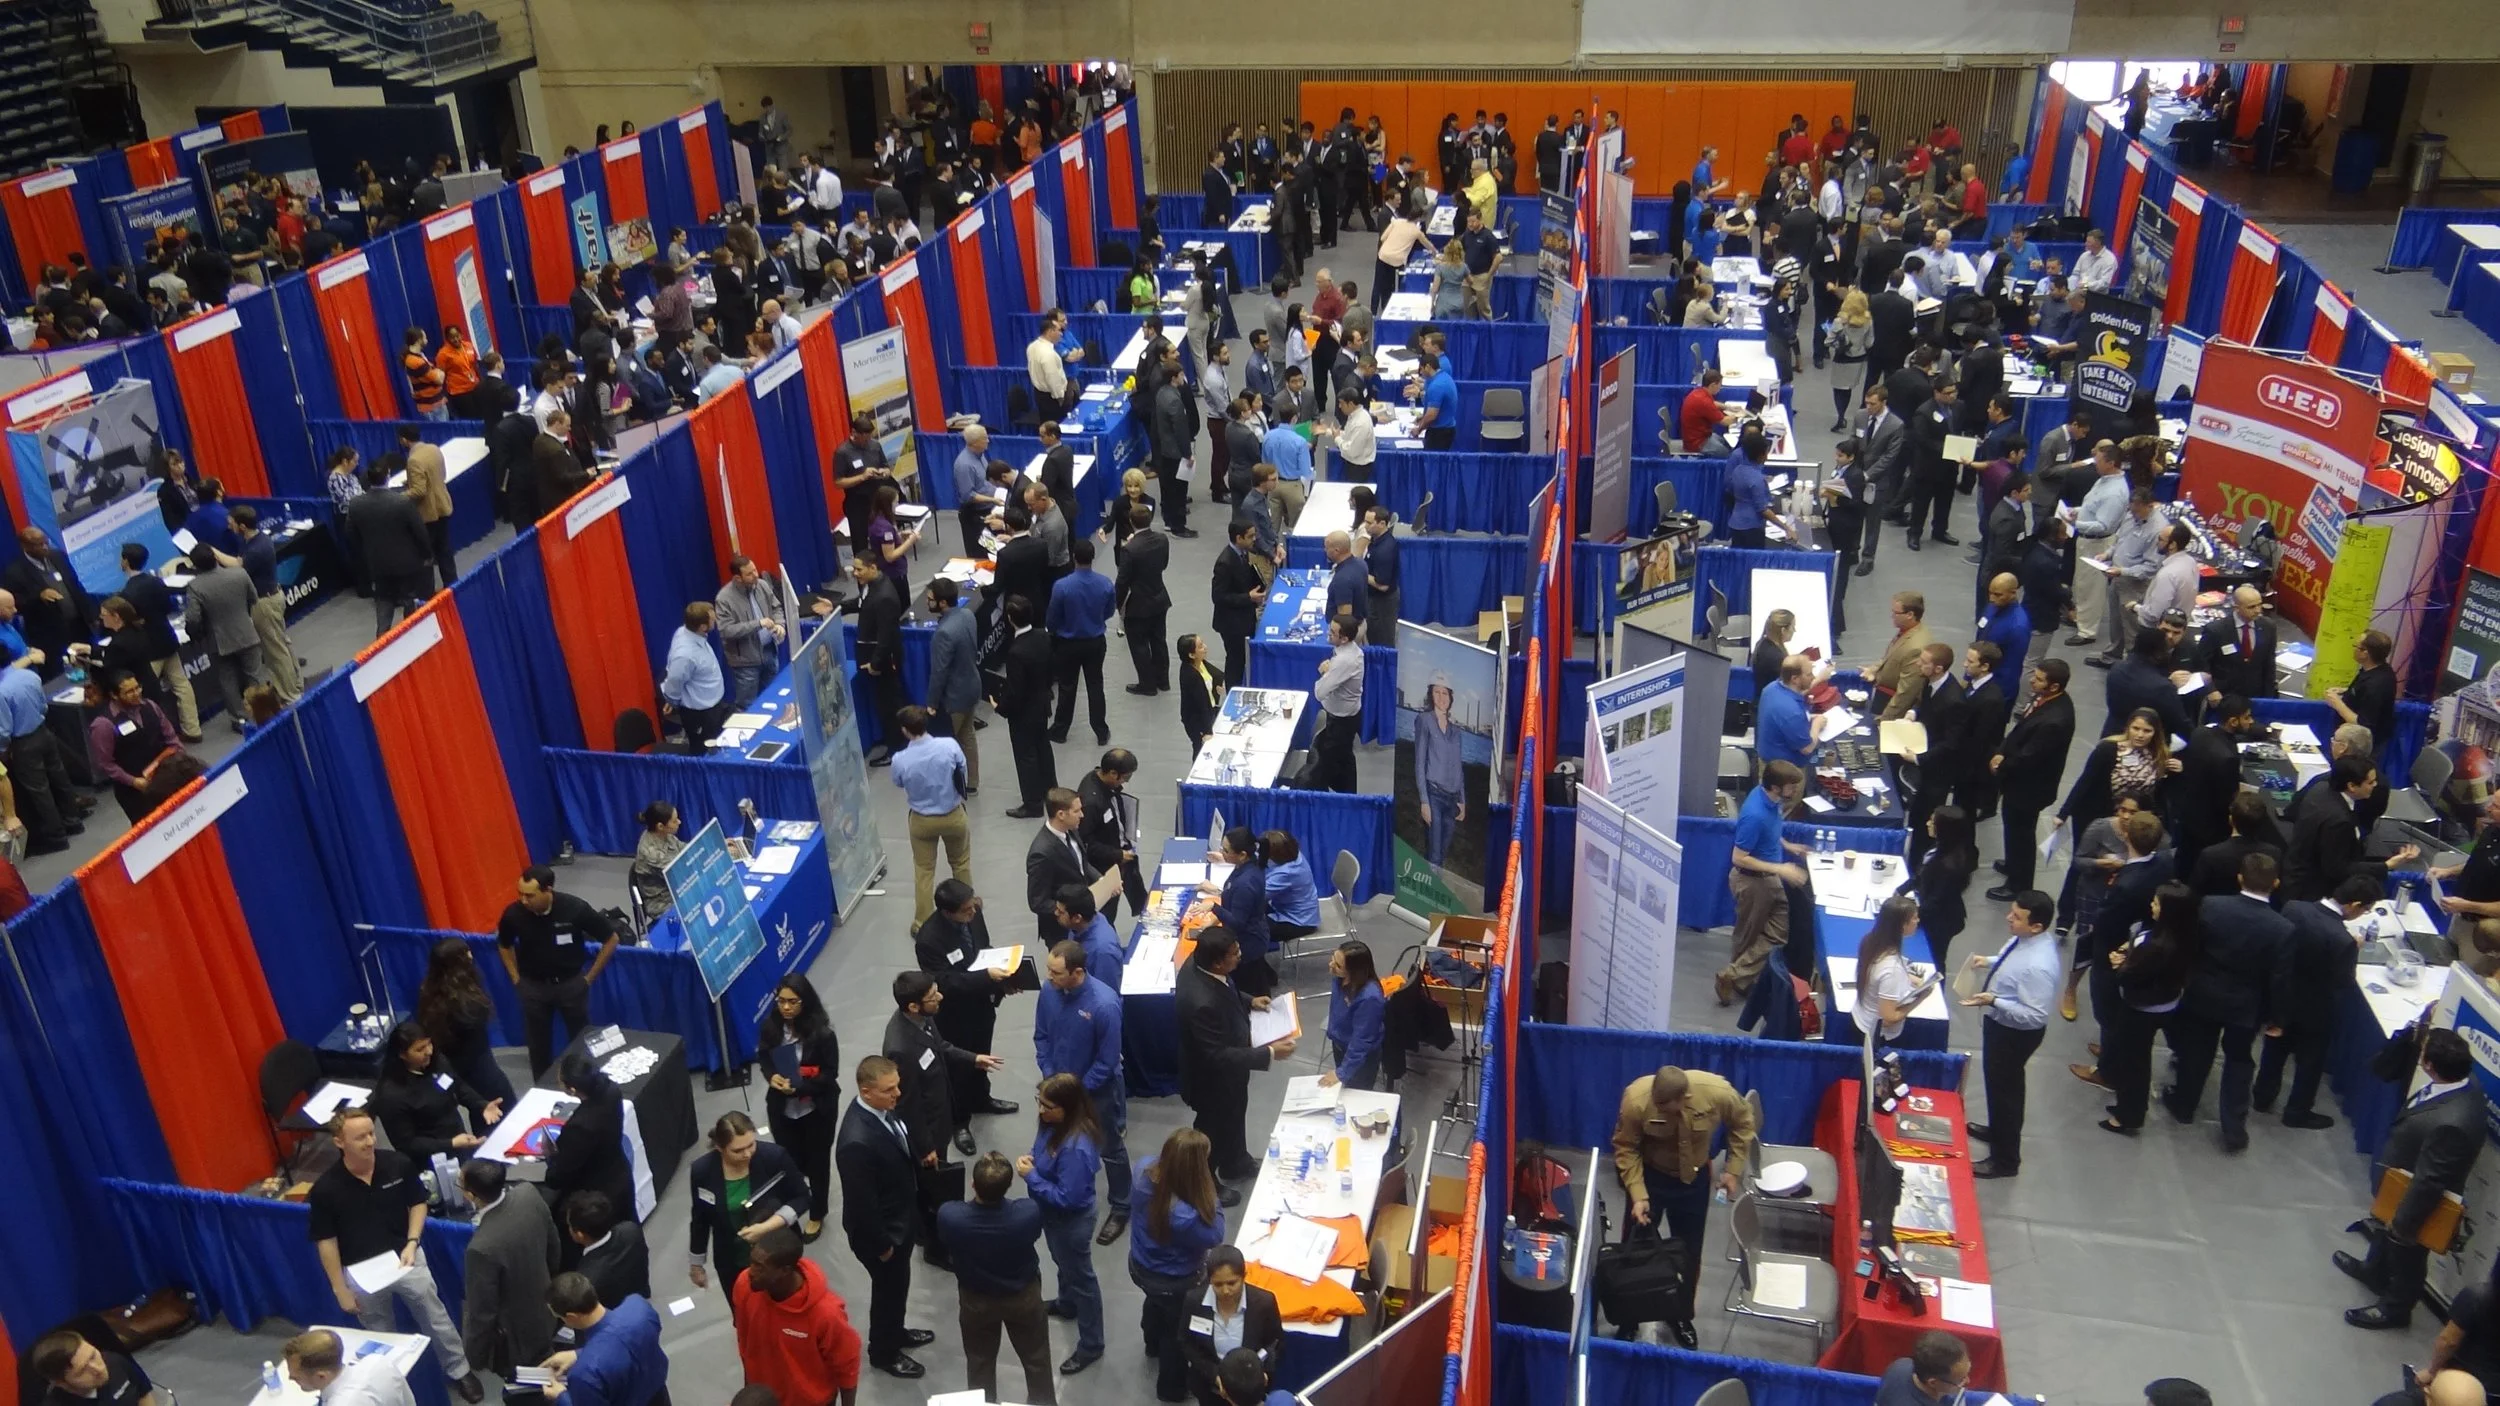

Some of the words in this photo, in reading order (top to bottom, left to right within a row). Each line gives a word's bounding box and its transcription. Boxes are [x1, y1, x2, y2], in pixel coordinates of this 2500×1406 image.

[128, 209, 163, 229] research
[153, 207, 197, 229] imagination
[2090, 311, 2121, 329] golden
[2121, 318, 2142, 336] frog
[2082, 366, 2106, 379] TAKE
[2107, 369, 2132, 392] BACK
[2095, 380, 2115, 390] YOUR
[1600, 380, 1619, 402] ARGO
[2082, 382, 2127, 407] INTERNET
[2322, 461, 2334, 473] MI
[2336, 466, 2361, 489] TIENDA
[2209, 513, 2226, 528] be
[2218, 482, 2295, 539] YOU
[2308, 508, 2339, 547] PARTNER
[2289, 532, 2310, 549] can
[1626, 600, 1638, 610] OUR
[1653, 588, 1668, 600] YOUR
[2462, 608, 2486, 624] NEW
[2460, 620, 2473, 631] for
[2473, 626, 2489, 638] the
[976, 620, 1006, 666] ortens
[1617, 677, 1672, 706] INTERNSHIPS
[1396, 857, 1412, 878] I
[1412, 871, 1433, 887] am
